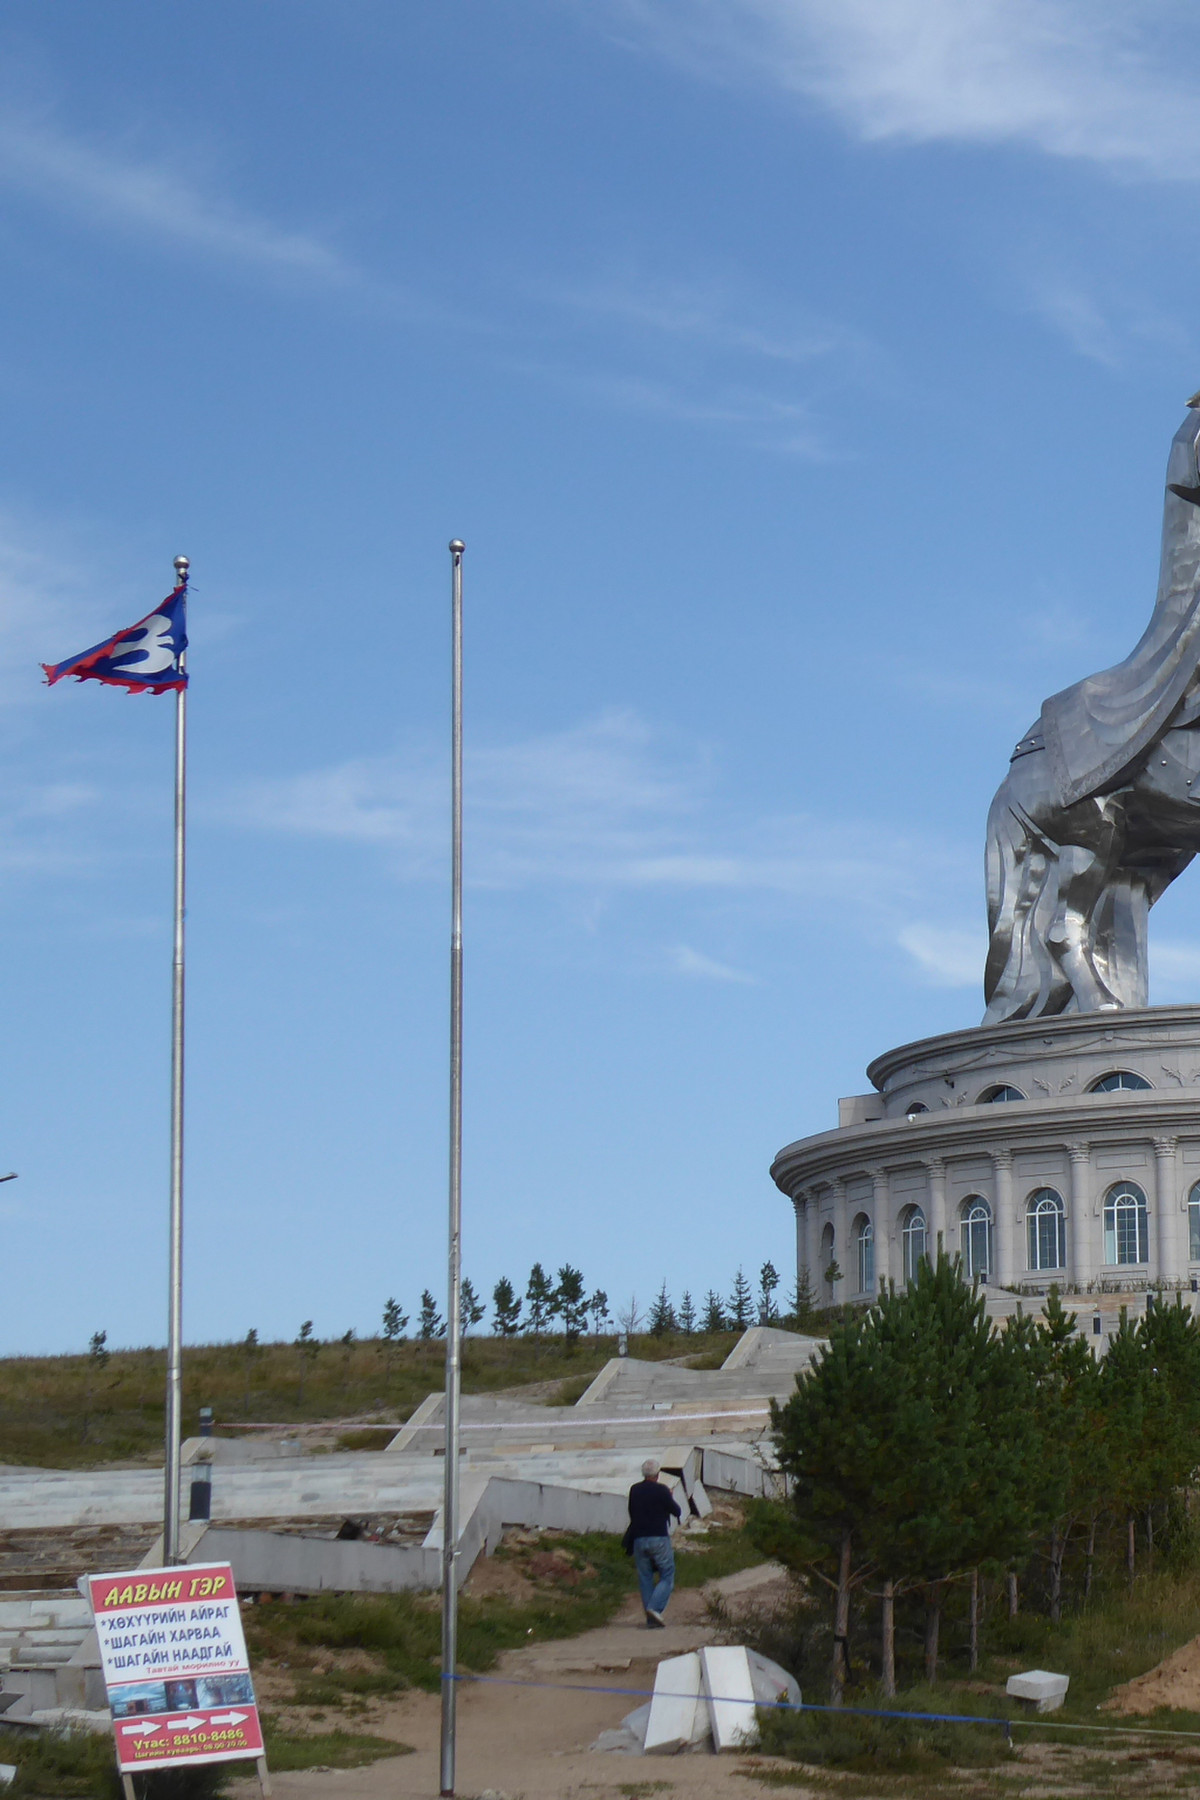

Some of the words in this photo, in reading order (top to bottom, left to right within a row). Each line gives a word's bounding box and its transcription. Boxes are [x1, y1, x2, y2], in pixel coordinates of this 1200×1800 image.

[189, 1576, 226, 1597] ГЭР
[190, 1605, 230, 1621] АЙРАГ
[111, 1629, 166, 1649] ШАГАЙН
[170, 1626, 221, 1643] ХАРВАА
[113, 1649, 169, 1669] ШАГАЙН
[173, 1641, 233, 1662] НААДГАЙ
[133, 1738, 170, 1750] Утас:
[173, 1728, 245, 1746] 8810-8486
